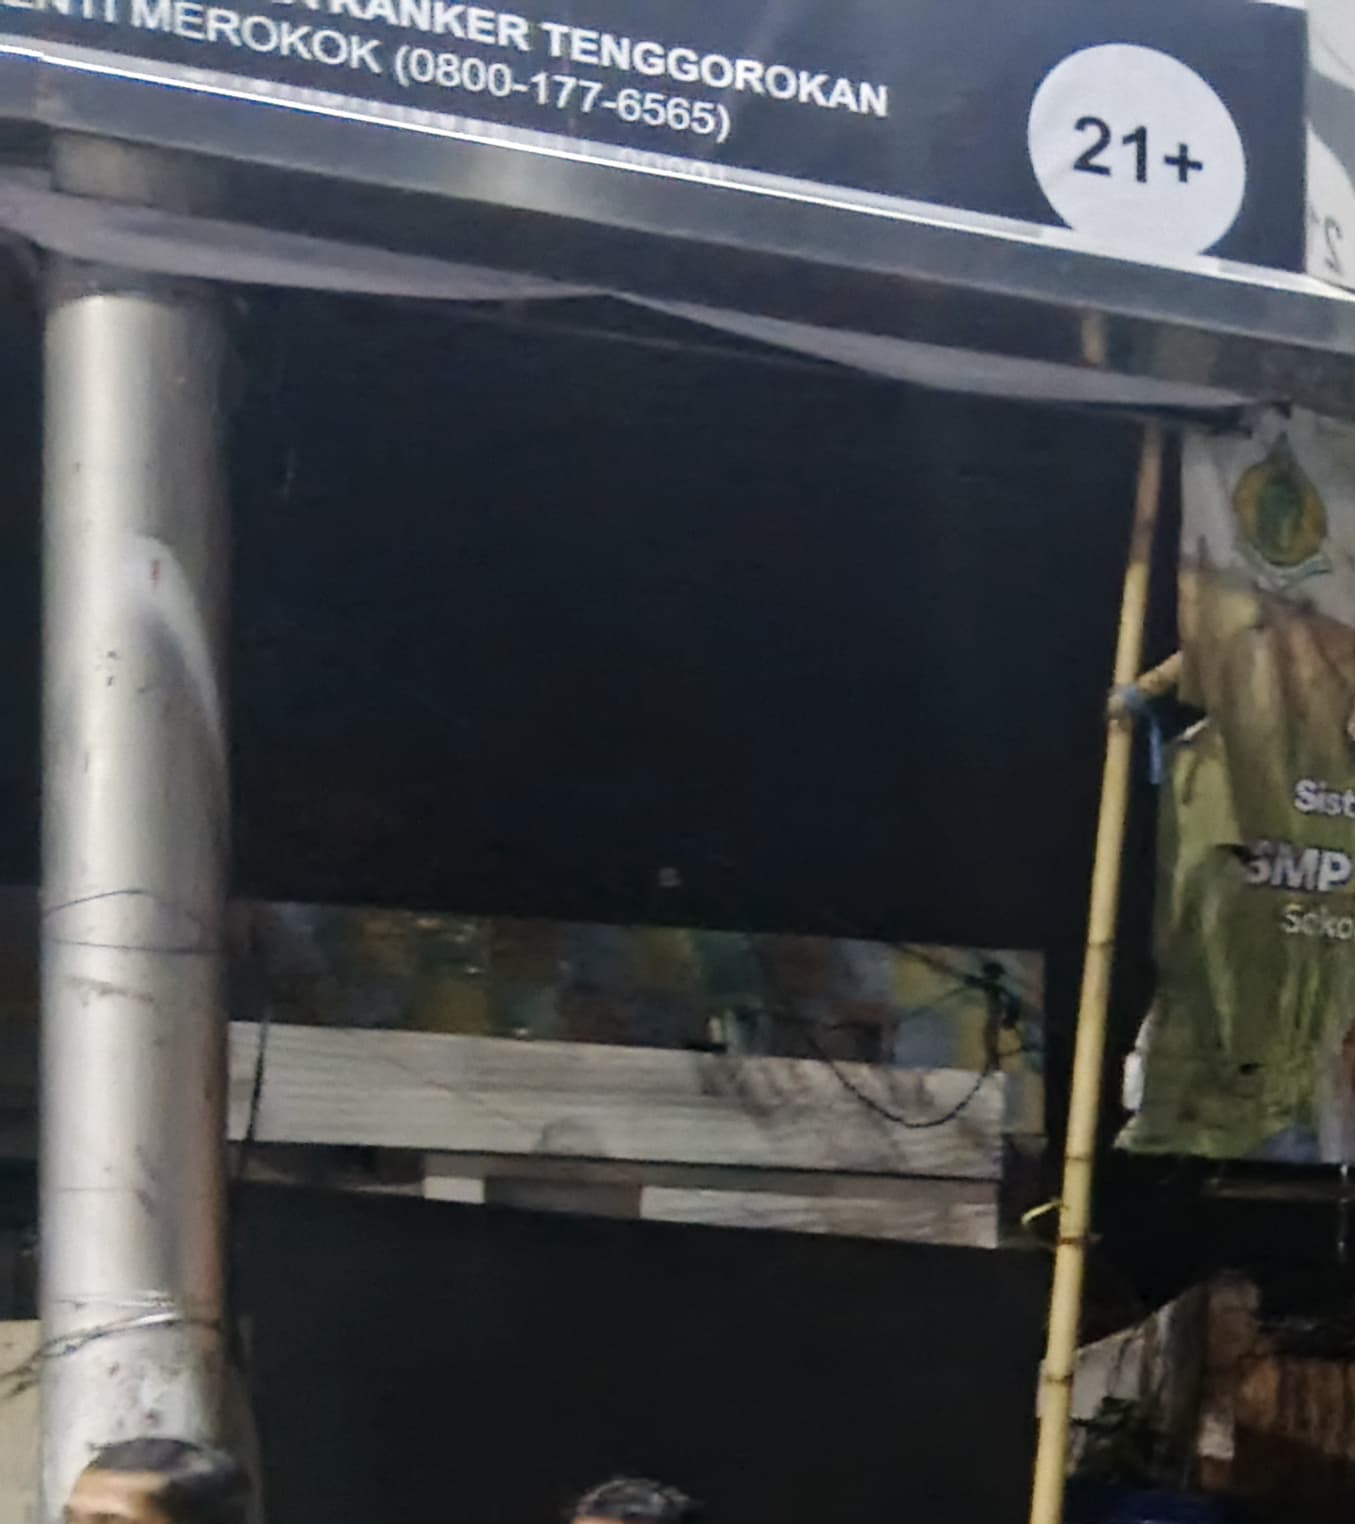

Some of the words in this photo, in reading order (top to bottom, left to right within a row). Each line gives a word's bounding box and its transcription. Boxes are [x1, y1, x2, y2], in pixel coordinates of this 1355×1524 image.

[130, 0, 382, 74] MEROKOK
[394, 45, 732, 143] (0800-177-6565)
[541, 21, 888, 118] TENGGOROKAN
[1071, 115, 1204, 184] 21+
[1246, 840, 1351, 892] SMP
